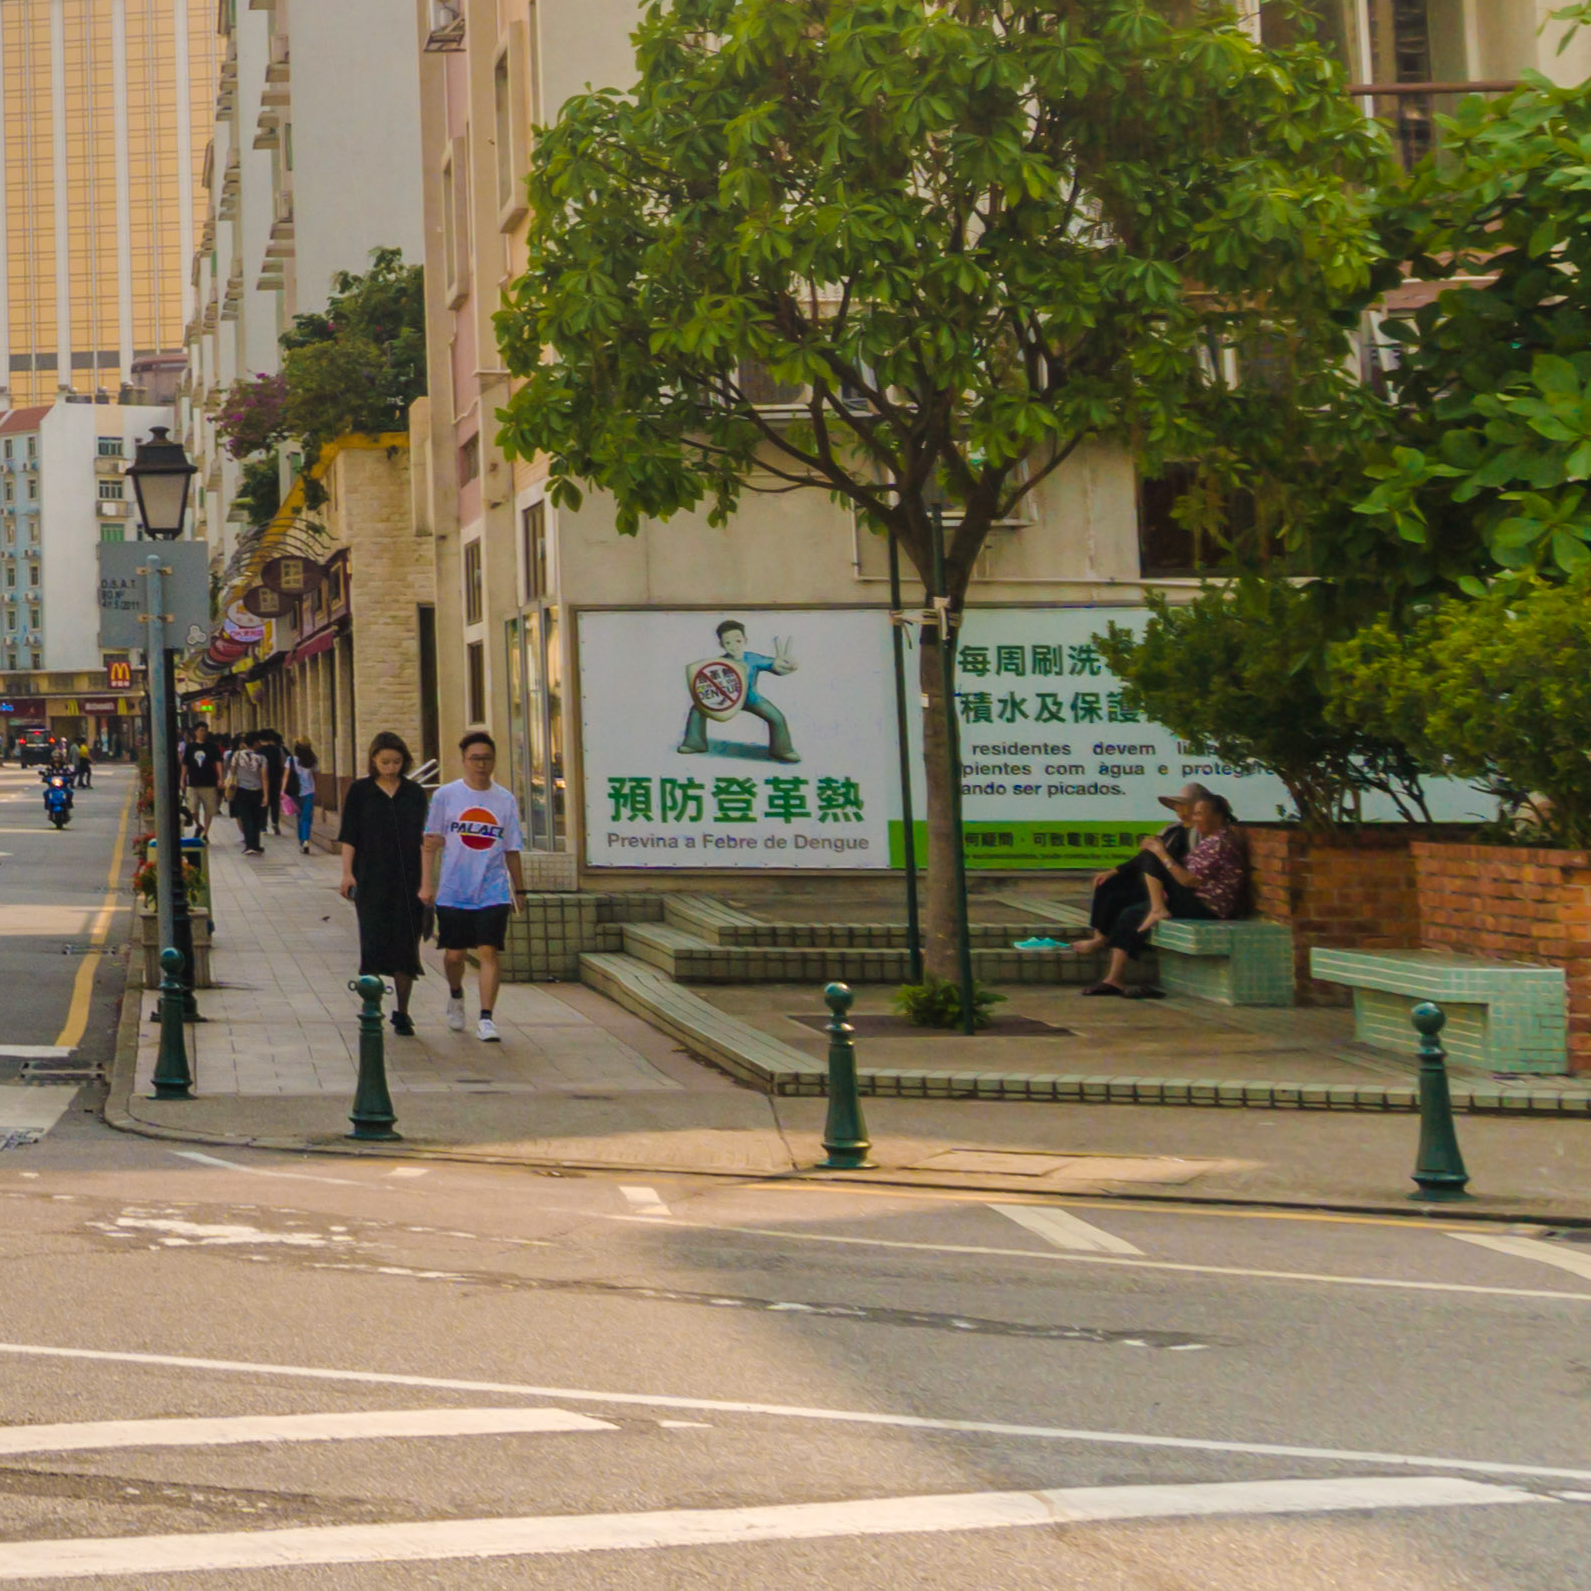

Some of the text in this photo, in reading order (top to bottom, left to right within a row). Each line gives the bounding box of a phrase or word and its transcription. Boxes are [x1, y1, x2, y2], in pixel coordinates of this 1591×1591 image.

[957, 641, 1101, 677] 每周刷洗
[972, 741, 1072, 756] residentes
[1092, 741, 1157, 756] devem
[962, 761, 1032, 778] pientes
[1044, 764, 1086, 776] com
[1157, 764, 1168, 776] e
[961, 781, 1127, 798] ando ser picados.
[607, 776, 865, 824] 預防登革熱
[607, 832, 869, 853] Previna a Febre de Dengue
